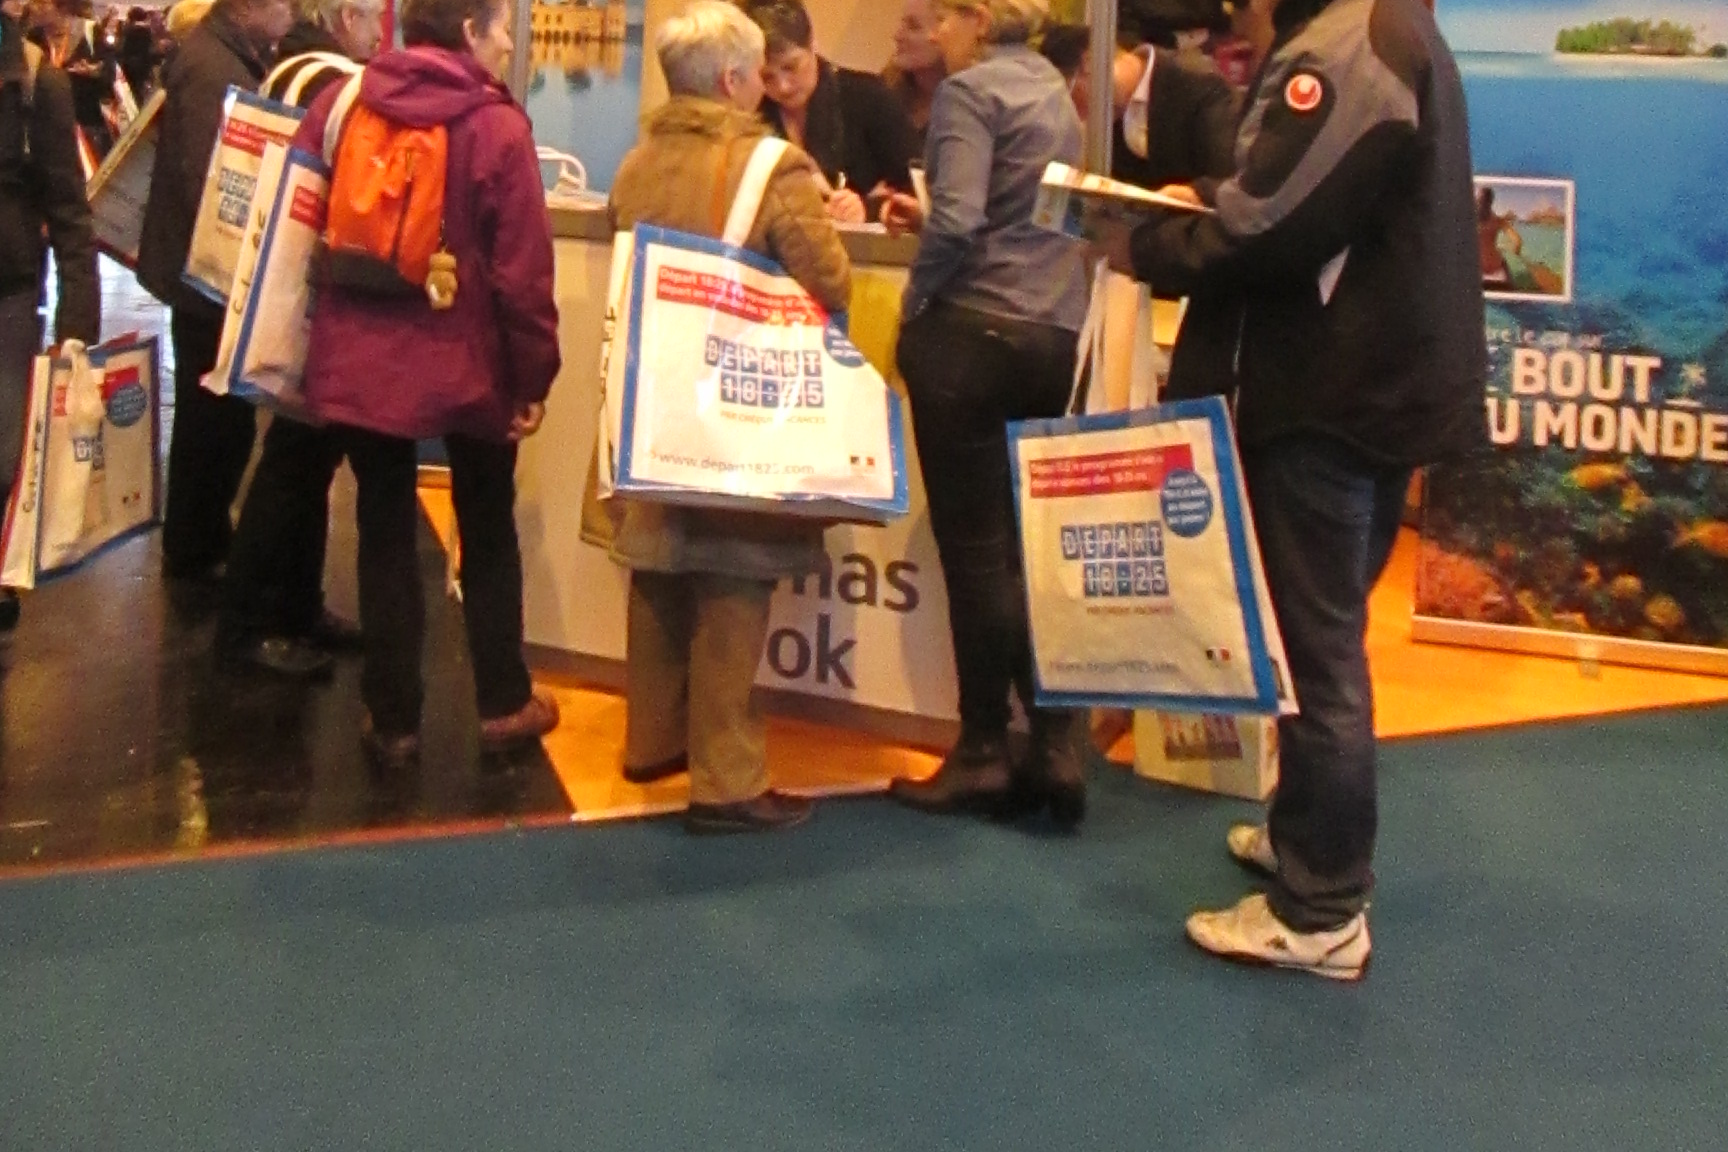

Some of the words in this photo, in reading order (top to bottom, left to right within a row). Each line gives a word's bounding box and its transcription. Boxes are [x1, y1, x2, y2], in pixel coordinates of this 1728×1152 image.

[1512, 348, 1662, 402] BOUT
[1533, 399, 1728, 462] MONDE
[767, 613, 857, 690] ok
